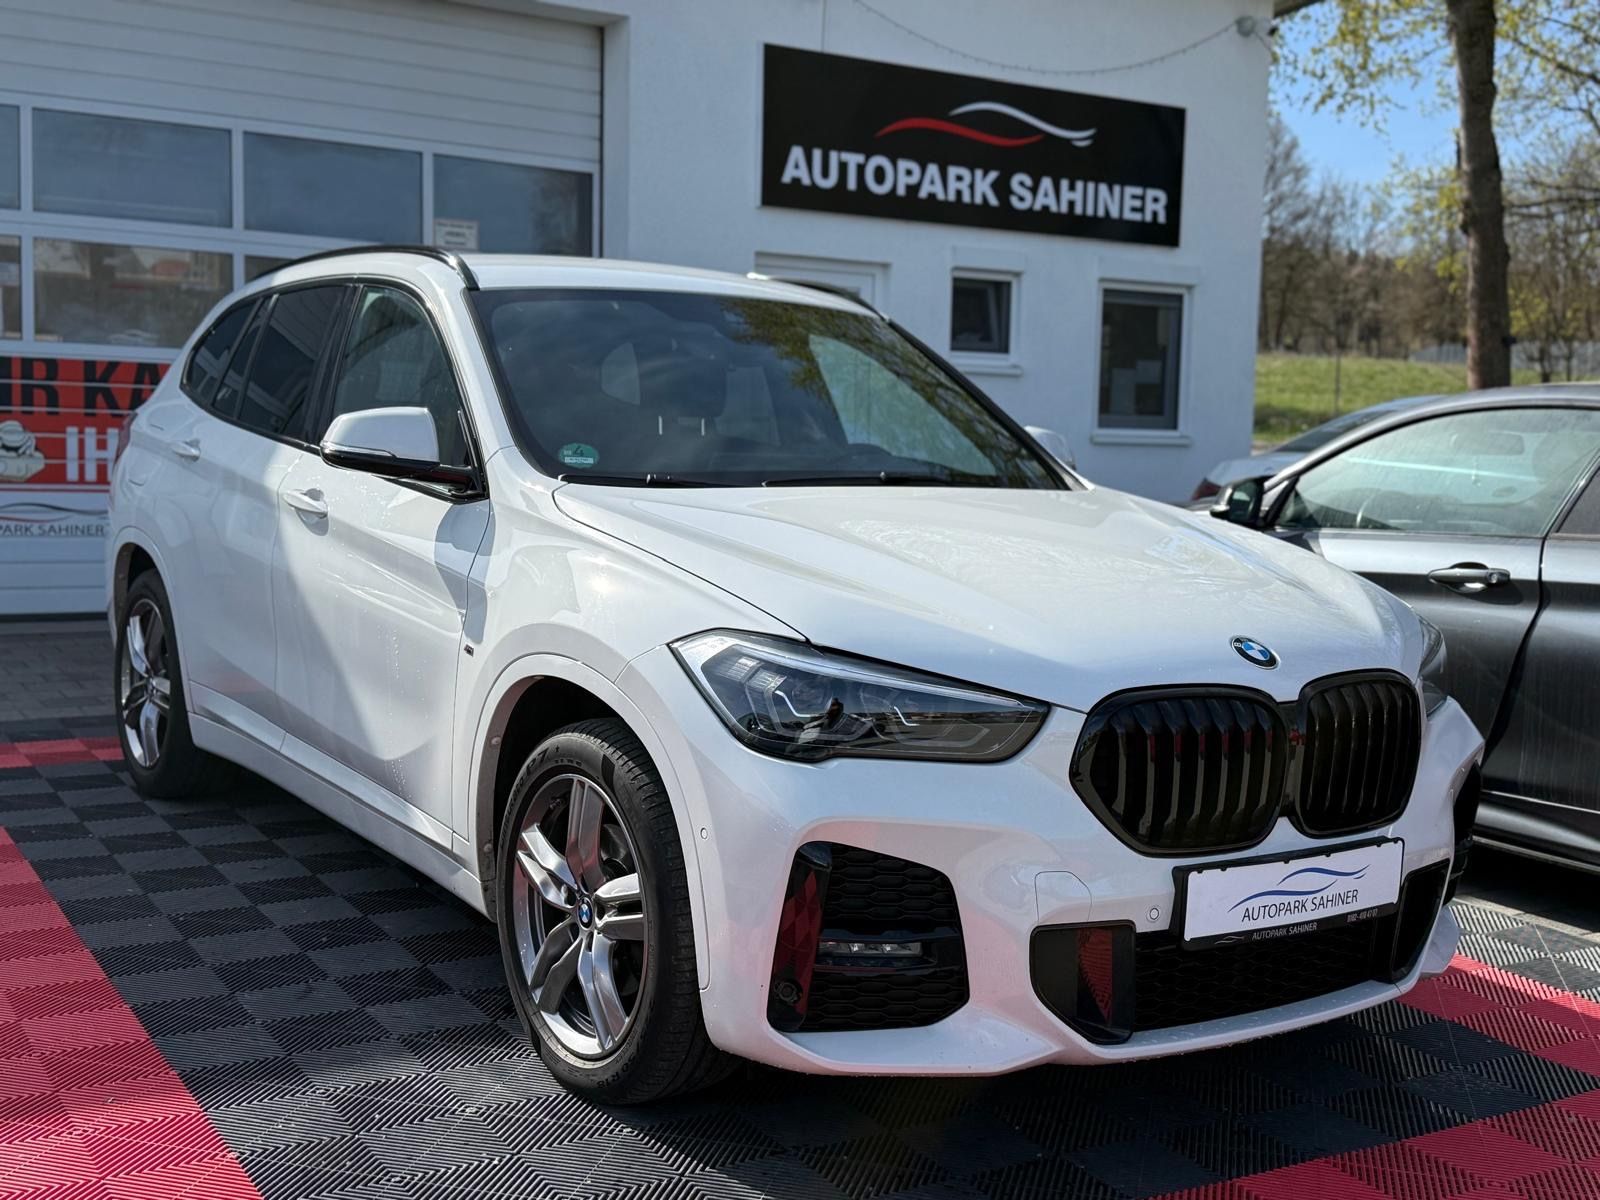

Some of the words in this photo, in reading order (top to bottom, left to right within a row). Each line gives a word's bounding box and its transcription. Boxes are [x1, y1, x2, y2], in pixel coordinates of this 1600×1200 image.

[781, 145, 1000, 207] AUTOPARK
[1008, 172, 1168, 224] SAHINER
[84, 359, 161, 417] KA
[65, 426, 119, 482] IH
[38, 523, 105, 537] SAHINER
[1241, 898, 1309, 922] AUTOPARK
[1310, 889, 1359, 912] SAHINER
[1252, 929, 1288, 941] AUTOPARK
[1288, 922, 1318, 936] SAHINER
